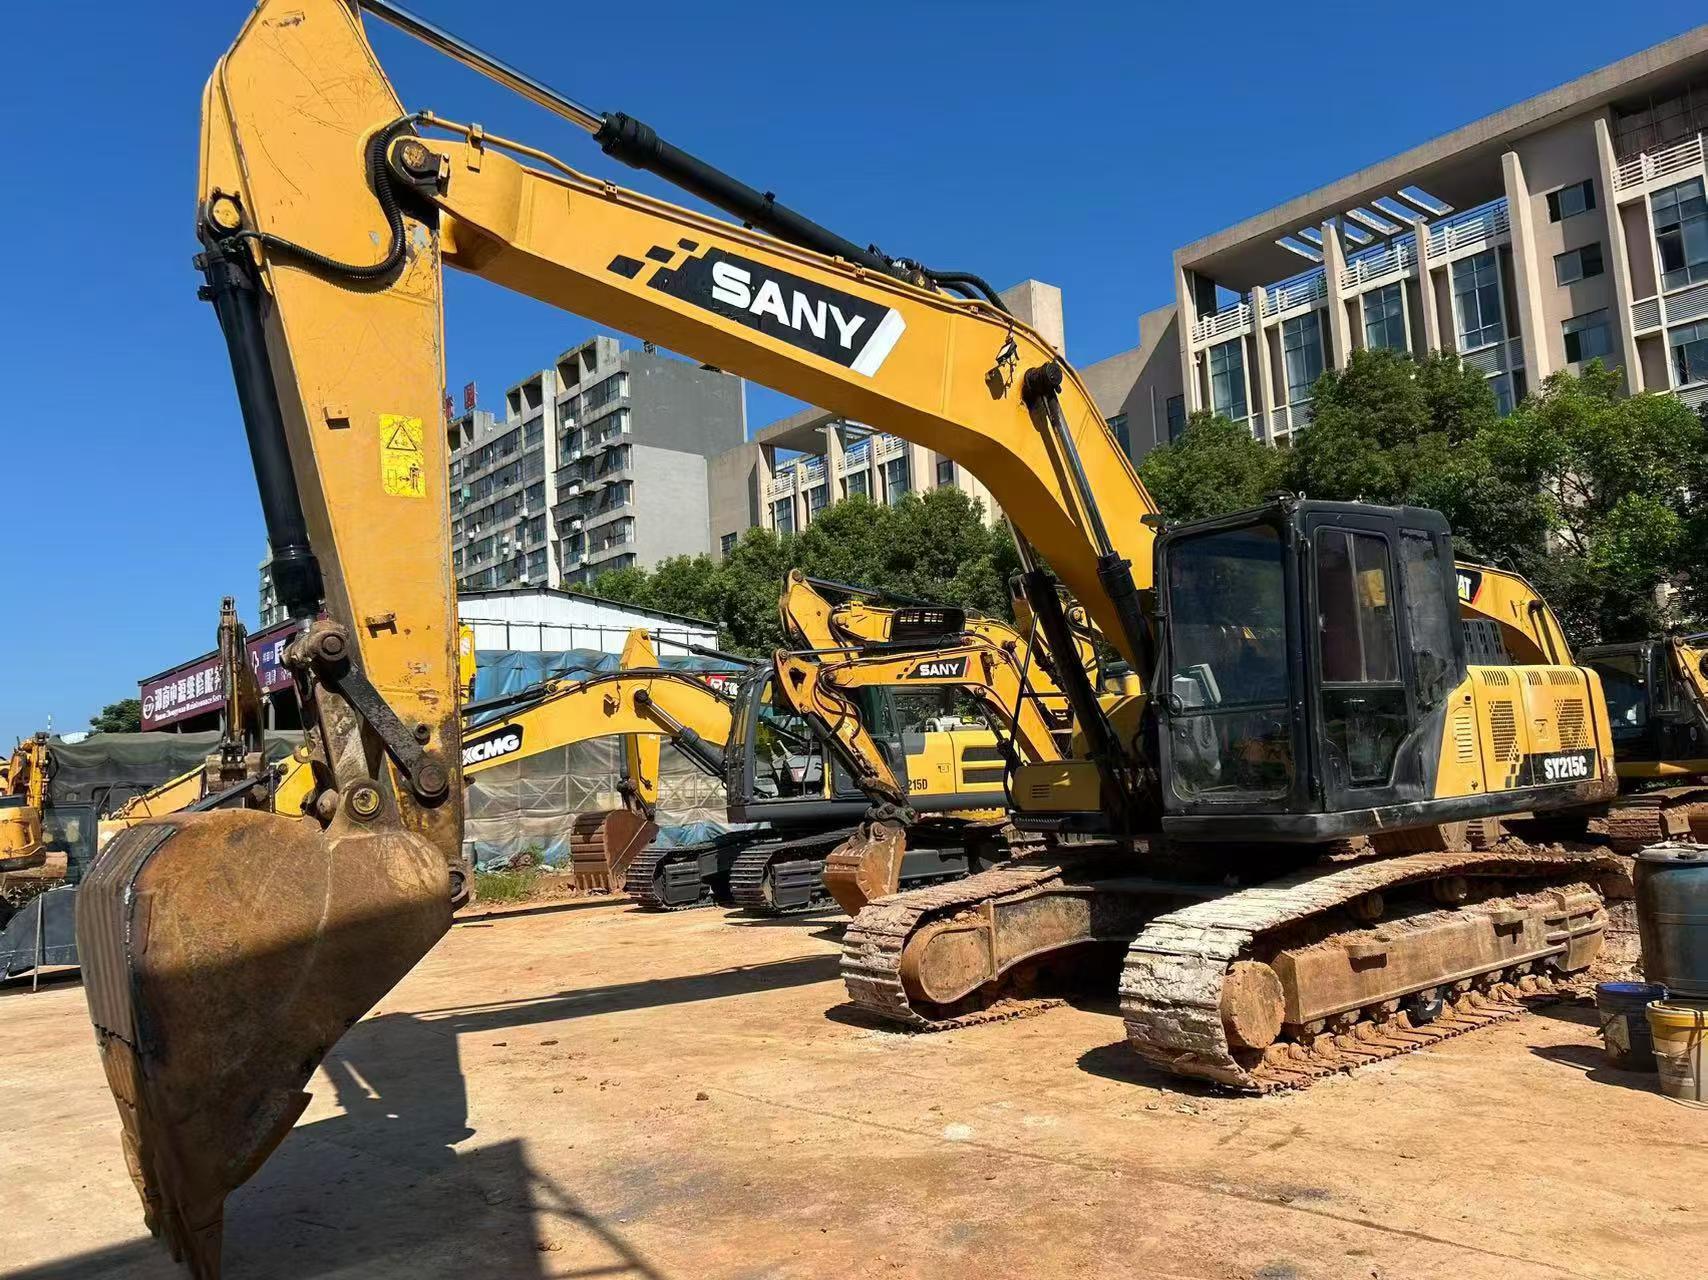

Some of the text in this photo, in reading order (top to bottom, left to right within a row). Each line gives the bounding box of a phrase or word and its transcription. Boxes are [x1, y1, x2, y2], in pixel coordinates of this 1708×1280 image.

[712, 260, 866, 350] SANY
[1456, 574, 1471, 600] AT
[920, 663, 959, 676] SANY
[1544, 755, 1588, 780] SY215C
